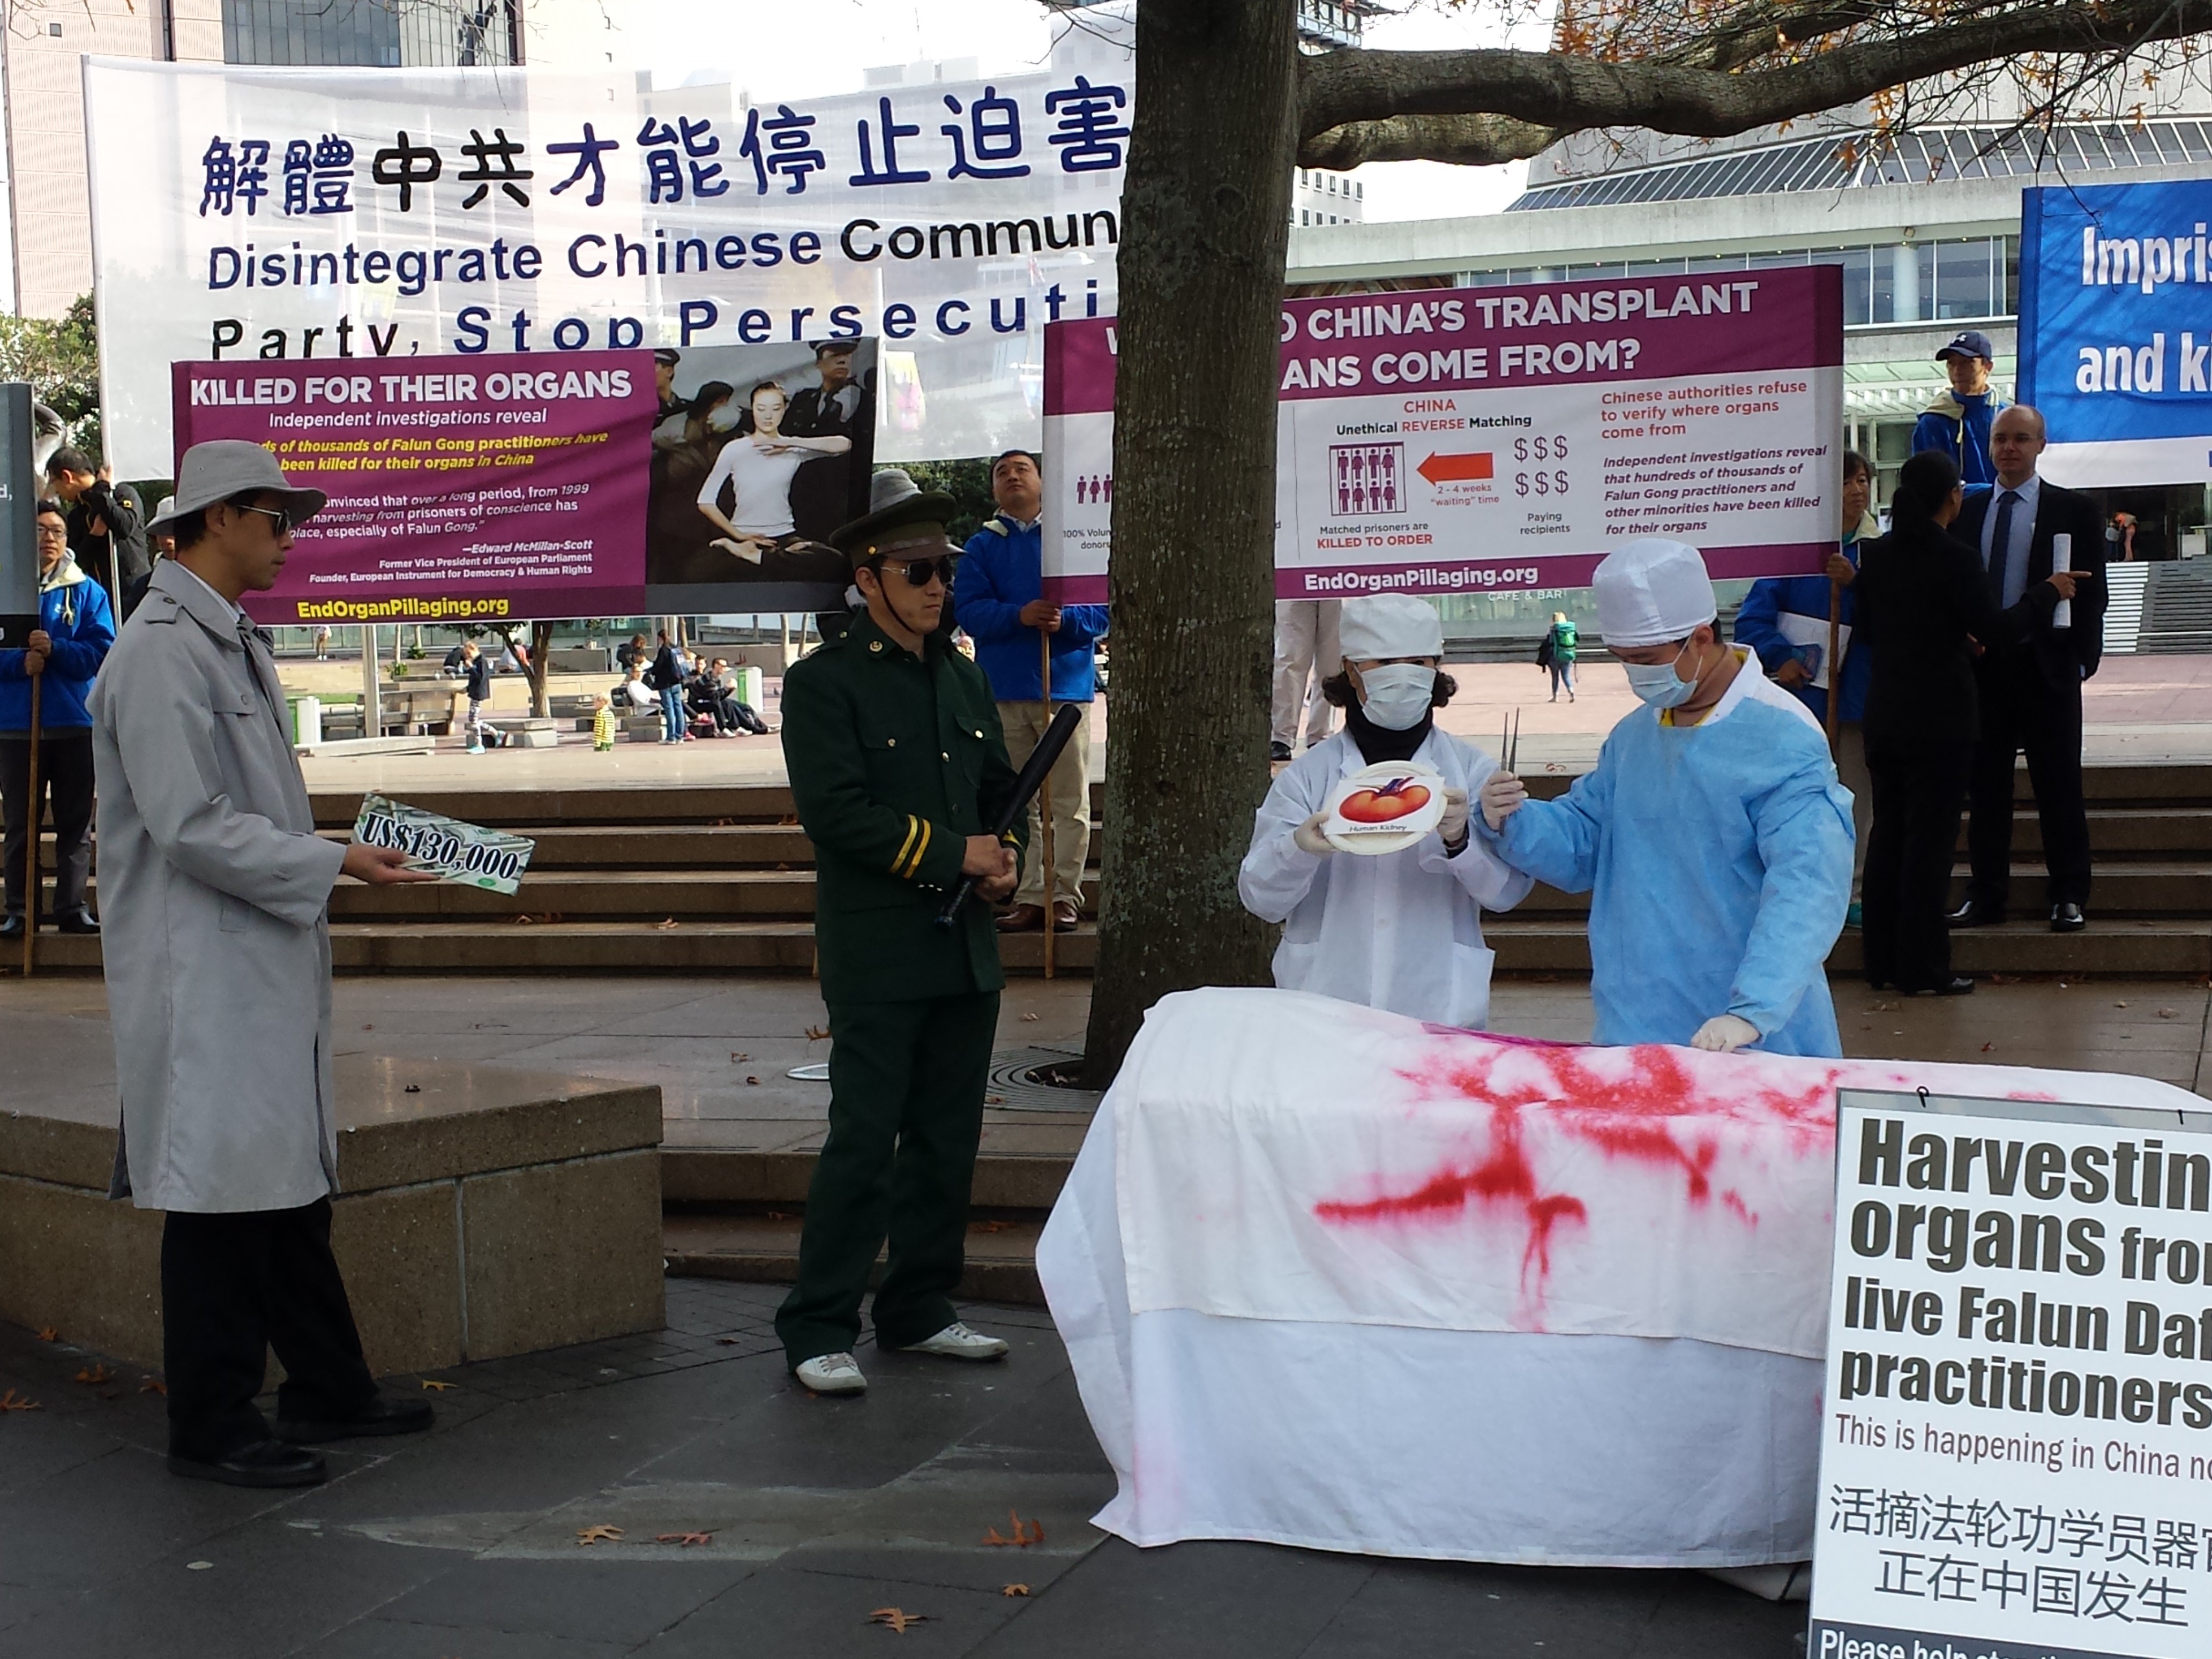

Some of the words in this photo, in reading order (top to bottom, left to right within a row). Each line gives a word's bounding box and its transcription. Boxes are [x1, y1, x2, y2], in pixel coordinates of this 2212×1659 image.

[199, 74, 1131, 216] 解體中共才能停止迫害
[208, 237, 542, 295] Disintegrate
[568, 230, 821, 278] Chinese
[1308, 300, 1466, 340] CHINA’S
[1476, 281, 1759, 330] TRANSPLANT
[454, 306, 644, 353] Stop
[1372, 348, 1488, 384] COME
[1500, 338, 1640, 377] FROM?
[2076, 333, 2165, 393] and
[2179, 332, 2212, 392] k
[191, 378, 297, 406] KILLED
[305, 376, 372, 404] FOR
[380, 374, 477, 402] THEIR
[485, 370, 632, 400] ORGANS
[1602, 391, 1663, 405] Chinese
[1668, 384, 1753, 400] authorities
[1758, 380, 1807, 395] refuse
[1403, 398, 1456, 413] CHINA
[1602, 408, 1617, 421] to
[1622, 406, 1667, 421] verify
[1672, 403, 1720, 417] where
[1725, 401, 1780, 416] organs
[270, 412, 371, 430] Independent
[377, 409, 491, 428] investigations
[496, 408, 547, 424] reveal
[1336, 422, 1398, 436] Unethical
[1402, 419, 1465, 433] REVERSE
[1469, 415, 1532, 429] Matching
[280, 439, 296, 452] of
[298, 439, 369, 452] thousands
[373, 438, 390, 451] of
[392, 438, 431, 450] Falun
[436, 438, 474, 452] Gong
[479, 435, 572, 451] practitioners
[574, 432, 608, 444] have
[1602, 427, 1644, 439] come
[1650, 423, 1686, 437] from
[280, 458, 315, 470] been
[318, 458, 356, 470] killed
[361, 458, 382, 470] for
[386, 457, 421, 469] their
[425, 457, 474, 470] organs
[478, 455, 492, 466] in
[495, 454, 534, 466] China
[1603, 453, 1687, 468] Independent
[1690, 448, 1783, 463] investigations
[1785, 444, 1827, 457] reveal
[1604, 474, 1632, 485] that
[1634, 471, 1695, 483] hundreds
[1699, 468, 1715, 480] of
[1716, 465, 1785, 479] thousands
[1789, 463, 1804, 476] of
[383, 495, 407, 506] that
[411, 496, 437, 505] over
[449, 491, 475, 503] long
[479, 487, 525, 502] period,
[528, 487, 557, 498] from
[562, 483, 589, 495] 1999
[1438, 486, 1444, 494] 2
[1453, 485, 1459, 493] 4
[1462, 484, 1492, 493] weeks
[1478, 495, 1500, 504] time
[1604, 488, 1640, 502] Falun
[1643, 487, 1678, 499] Gong
[1682, 483, 1767, 499] practitioners
[1770, 481, 1796, 492] and
[377, 510, 403, 520] from
[408, 507, 467, 519] prisoners
[470, 504, 483, 516] of
[487, 502, 552, 515] conscience
[556, 500, 578, 510] has
[1527, 512, 1562, 524] Paying
[1605, 506, 1640, 519] other
[1643, 503, 1709, 516] minorities
[1713, 500, 1744, 512] have
[1748, 498, 1780, 510] been
[1783, 496, 1820, 509] killed
[326, 524, 387, 539] especially
[391, 524, 404, 535] of
[408, 522, 441, 534] Falun
[1063, 529, 1085, 538] 100%
[1320, 523, 1361, 534] Matched
[1365, 522, 1410, 534] prisoners
[1413, 522, 1429, 531] are
[1520, 524, 1571, 535] recipients
[1605, 524, 1625, 535] for
[1628, 522, 1659, 534] their
[1663, 520, 1707, 533] organs
[514, 539, 593, 552] McMillan-Scott
[1317, 537, 1362, 549] KILLED
[1365, 536, 1383, 547] TO
[1388, 534, 1433, 546] ORDER
[379, 559, 412, 569] Former
[415, 558, 435, 567] Vice
[437, 557, 480, 567] President
[482, 556, 492, 565] of
[495, 556, 539, 566] European
[541, 552, 593, 563] Parliament
[309, 573, 348, 584] Founder,
[350, 572, 394, 583] European
[396, 570, 446, 580] Instrument
[448, 569, 461, 578] for
[464, 569, 515, 578] Democracy
[518, 567, 525, 576] &
[527, 566, 560, 575] Human
[562, 565, 593, 575] Rights
[1305, 566, 1538, 592] EndOrganPillaging.org
[1524, 591, 1533, 600] &
[1537, 590, 1562, 600] BAR
[297, 597, 509, 619] EndOrganPillaging.org
[363, 813, 518, 879] US$130,000
[1858, 1118, 2210, 1212] Harvestin
[1850, 1200, 2105, 1277] organs
[2120, 1227, 2212, 1286] fro
[1845, 1275, 1943, 1336] live
[1957, 1286, 2109, 1352] Falun
[1839, 1350, 2212, 1430] practitioners
[1836, 1413, 1886, 1447] This
[1895, 1419, 1916, 1451] is
[1924, 1423, 2064, 1473] happening
[2072, 1438, 2095, 1469] in
[2104, 1440, 2180, 1478] China
[1829, 1484, 2212, 1573] 活摘法轮功学员器
[1874, 1549, 2189, 1627] 正在中国发生
[1820, 1629, 1905, 1659] Please
